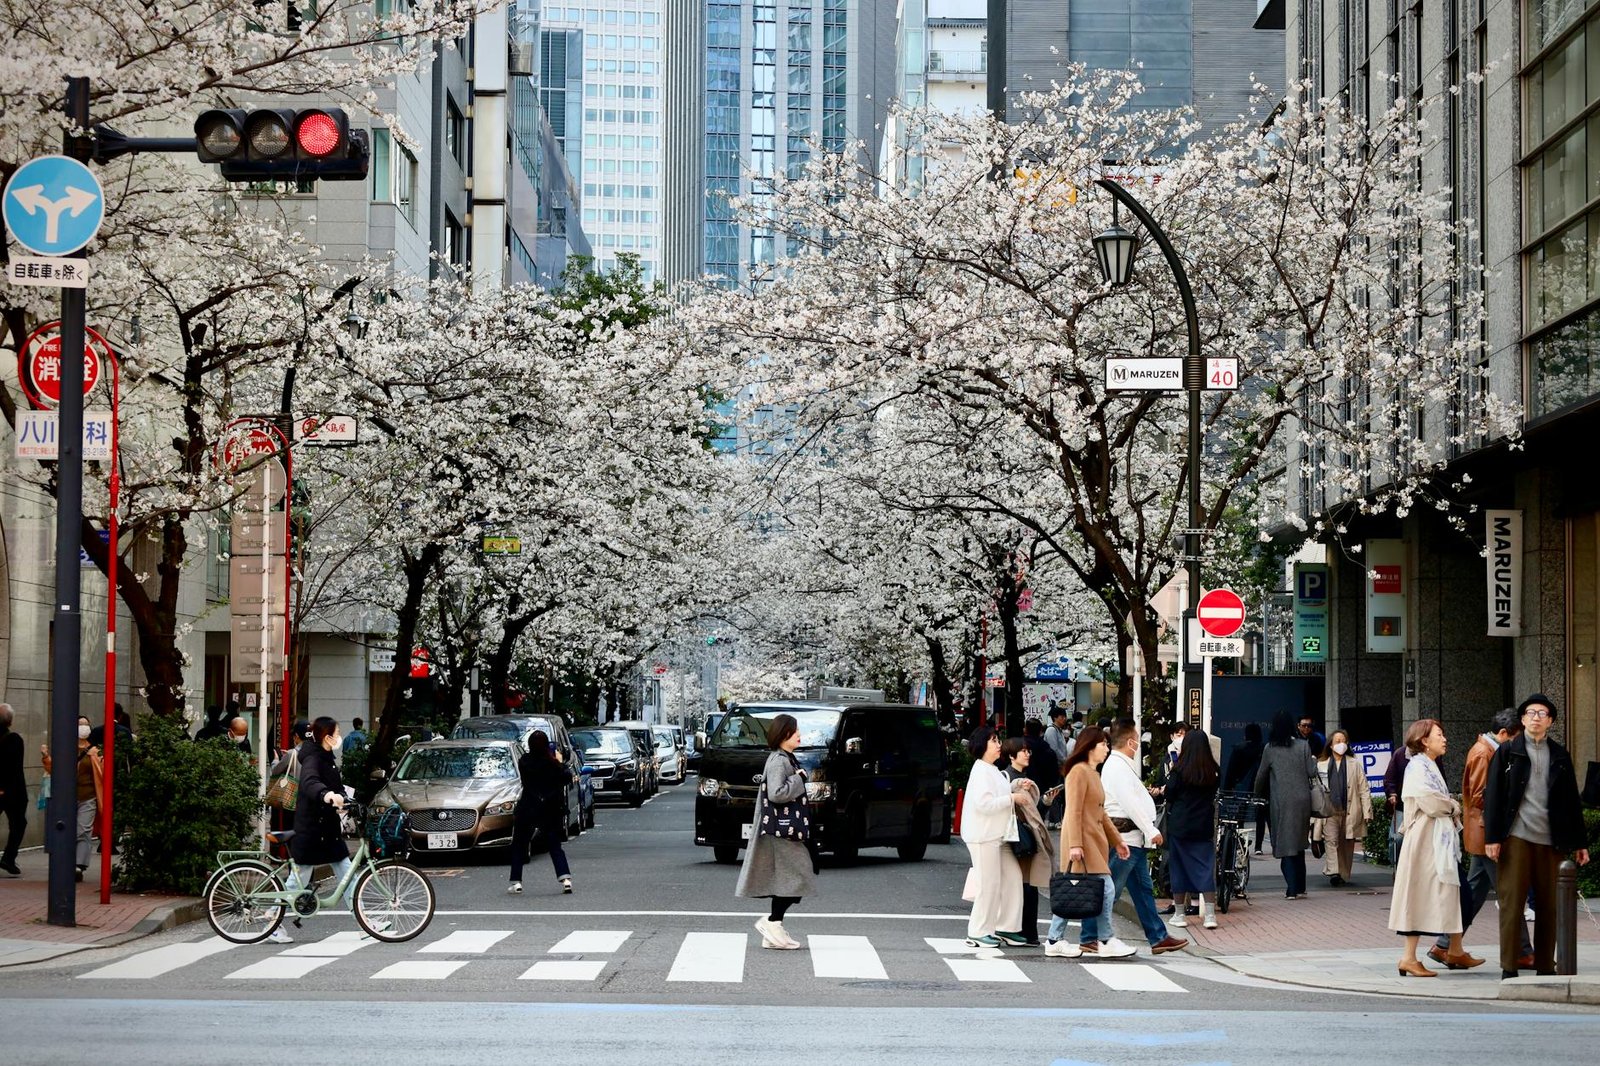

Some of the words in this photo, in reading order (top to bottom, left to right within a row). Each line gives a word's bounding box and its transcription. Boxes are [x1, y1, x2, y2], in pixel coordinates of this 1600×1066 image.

[15, 263, 83, 281] 自転車を除く
[43, 344, 58, 352] FIRE
[38, 356, 94, 381] 消栓
[1130, 370, 1179, 379] MARUZEN
[1211, 371, 1233, 385] 40
[20, 420, 107, 445] 八川科
[1494, 517, 1511, 628] MARUZEN
[1304, 574, 1321, 597] P
[1199, 642, 1241, 655] 自転車を除く
[1302, 637, 1320, 654] 空
[248, 695, 256, 705] A
[1352, 743, 1391, 752] イルーフ入庫可
[1363, 755, 1377, 775] P
